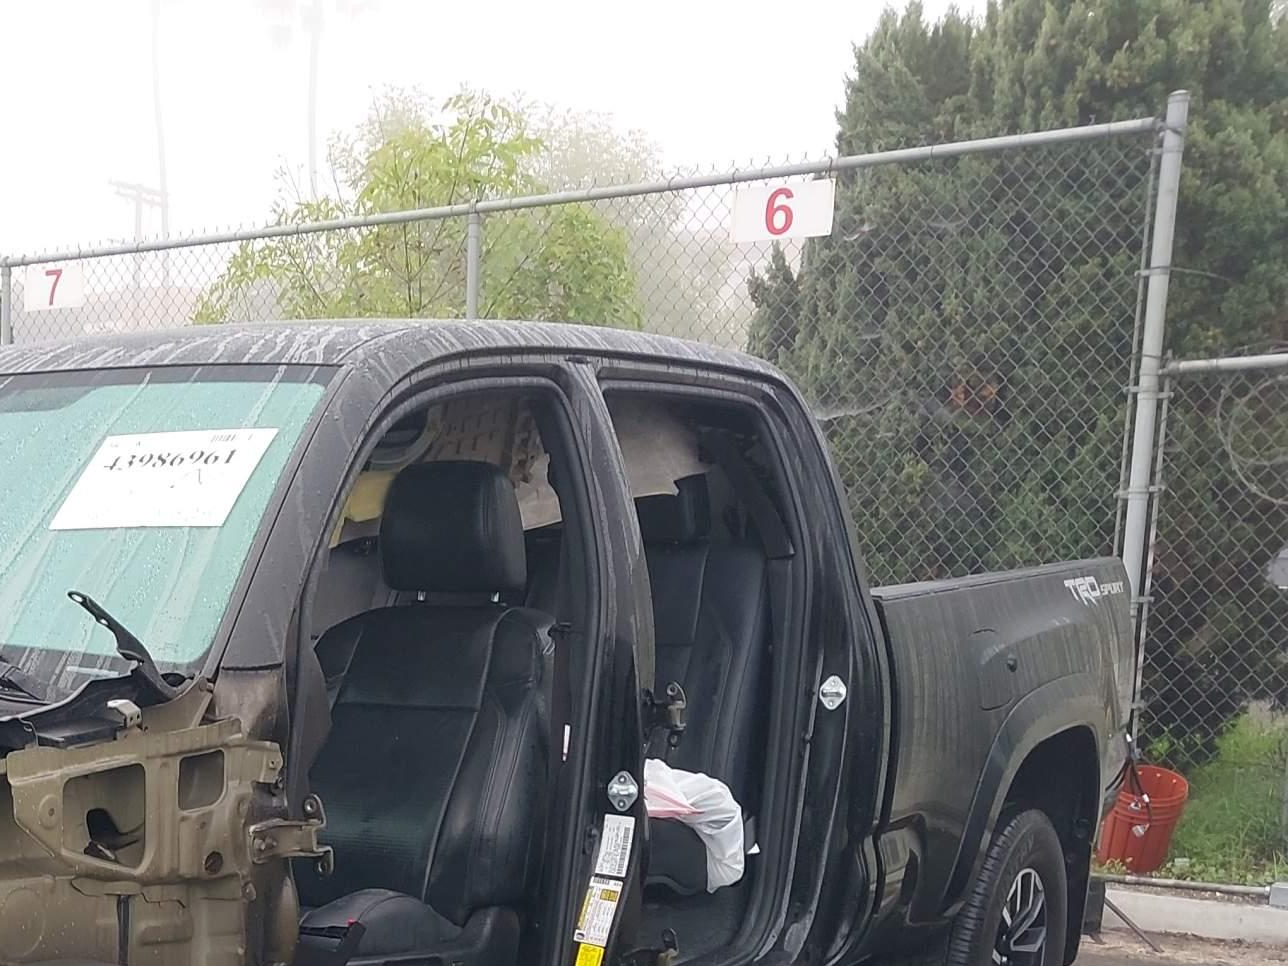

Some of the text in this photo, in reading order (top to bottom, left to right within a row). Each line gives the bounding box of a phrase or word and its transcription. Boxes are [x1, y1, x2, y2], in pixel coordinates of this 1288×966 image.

[765, 187, 794, 235] 6
[45, 268, 63, 306] 7
[103, 449, 238, 471] 43986961
[1064, 576, 1100, 605] TRD
